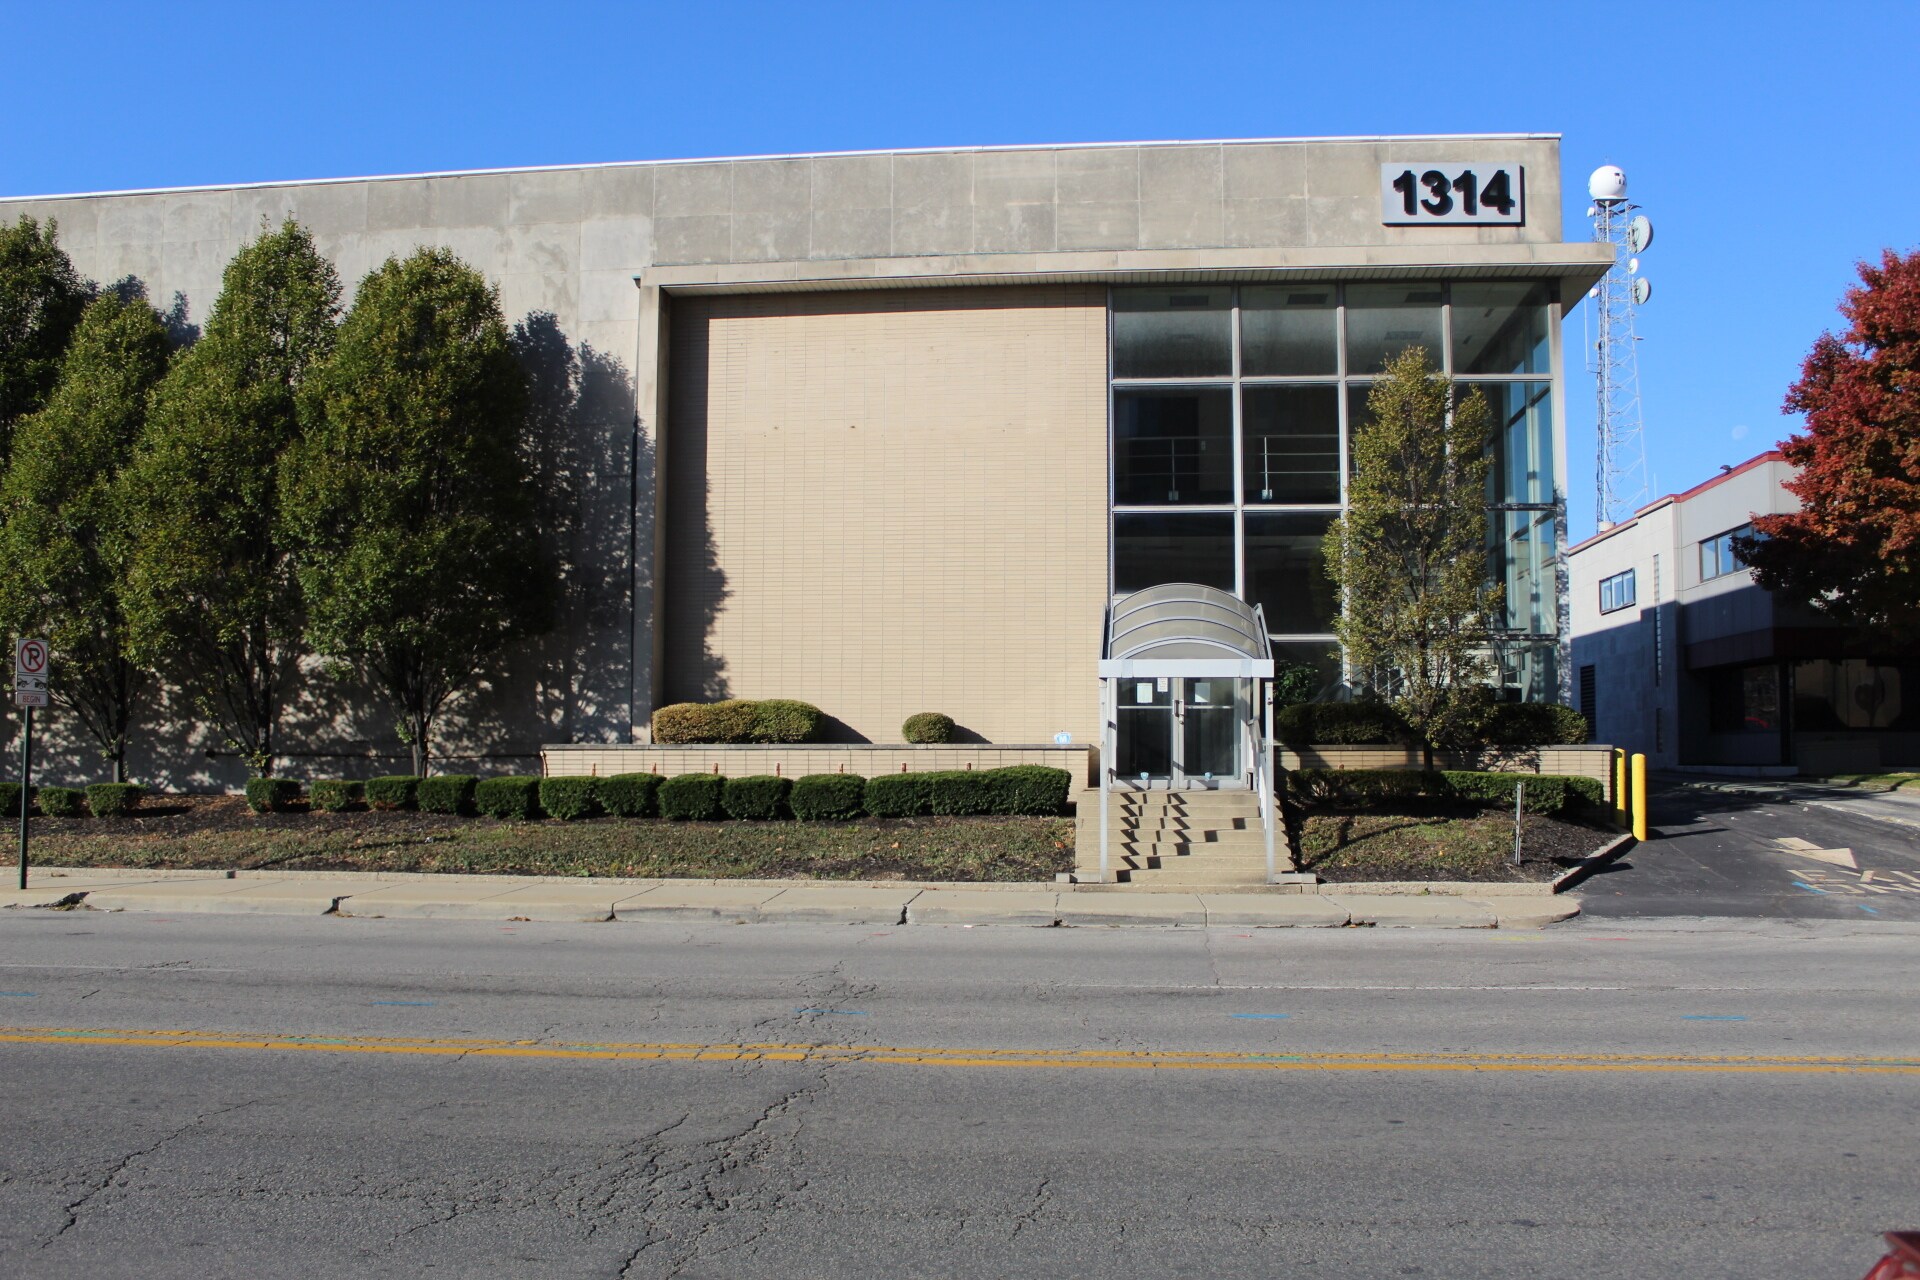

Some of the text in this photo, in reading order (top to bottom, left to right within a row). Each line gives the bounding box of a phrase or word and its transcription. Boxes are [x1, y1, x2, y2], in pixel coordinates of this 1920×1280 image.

[1393, 170, 1515, 216] 1314
[22, 695, 41, 703] BEGIN
[1787, 869, 1920, 882] EXI
